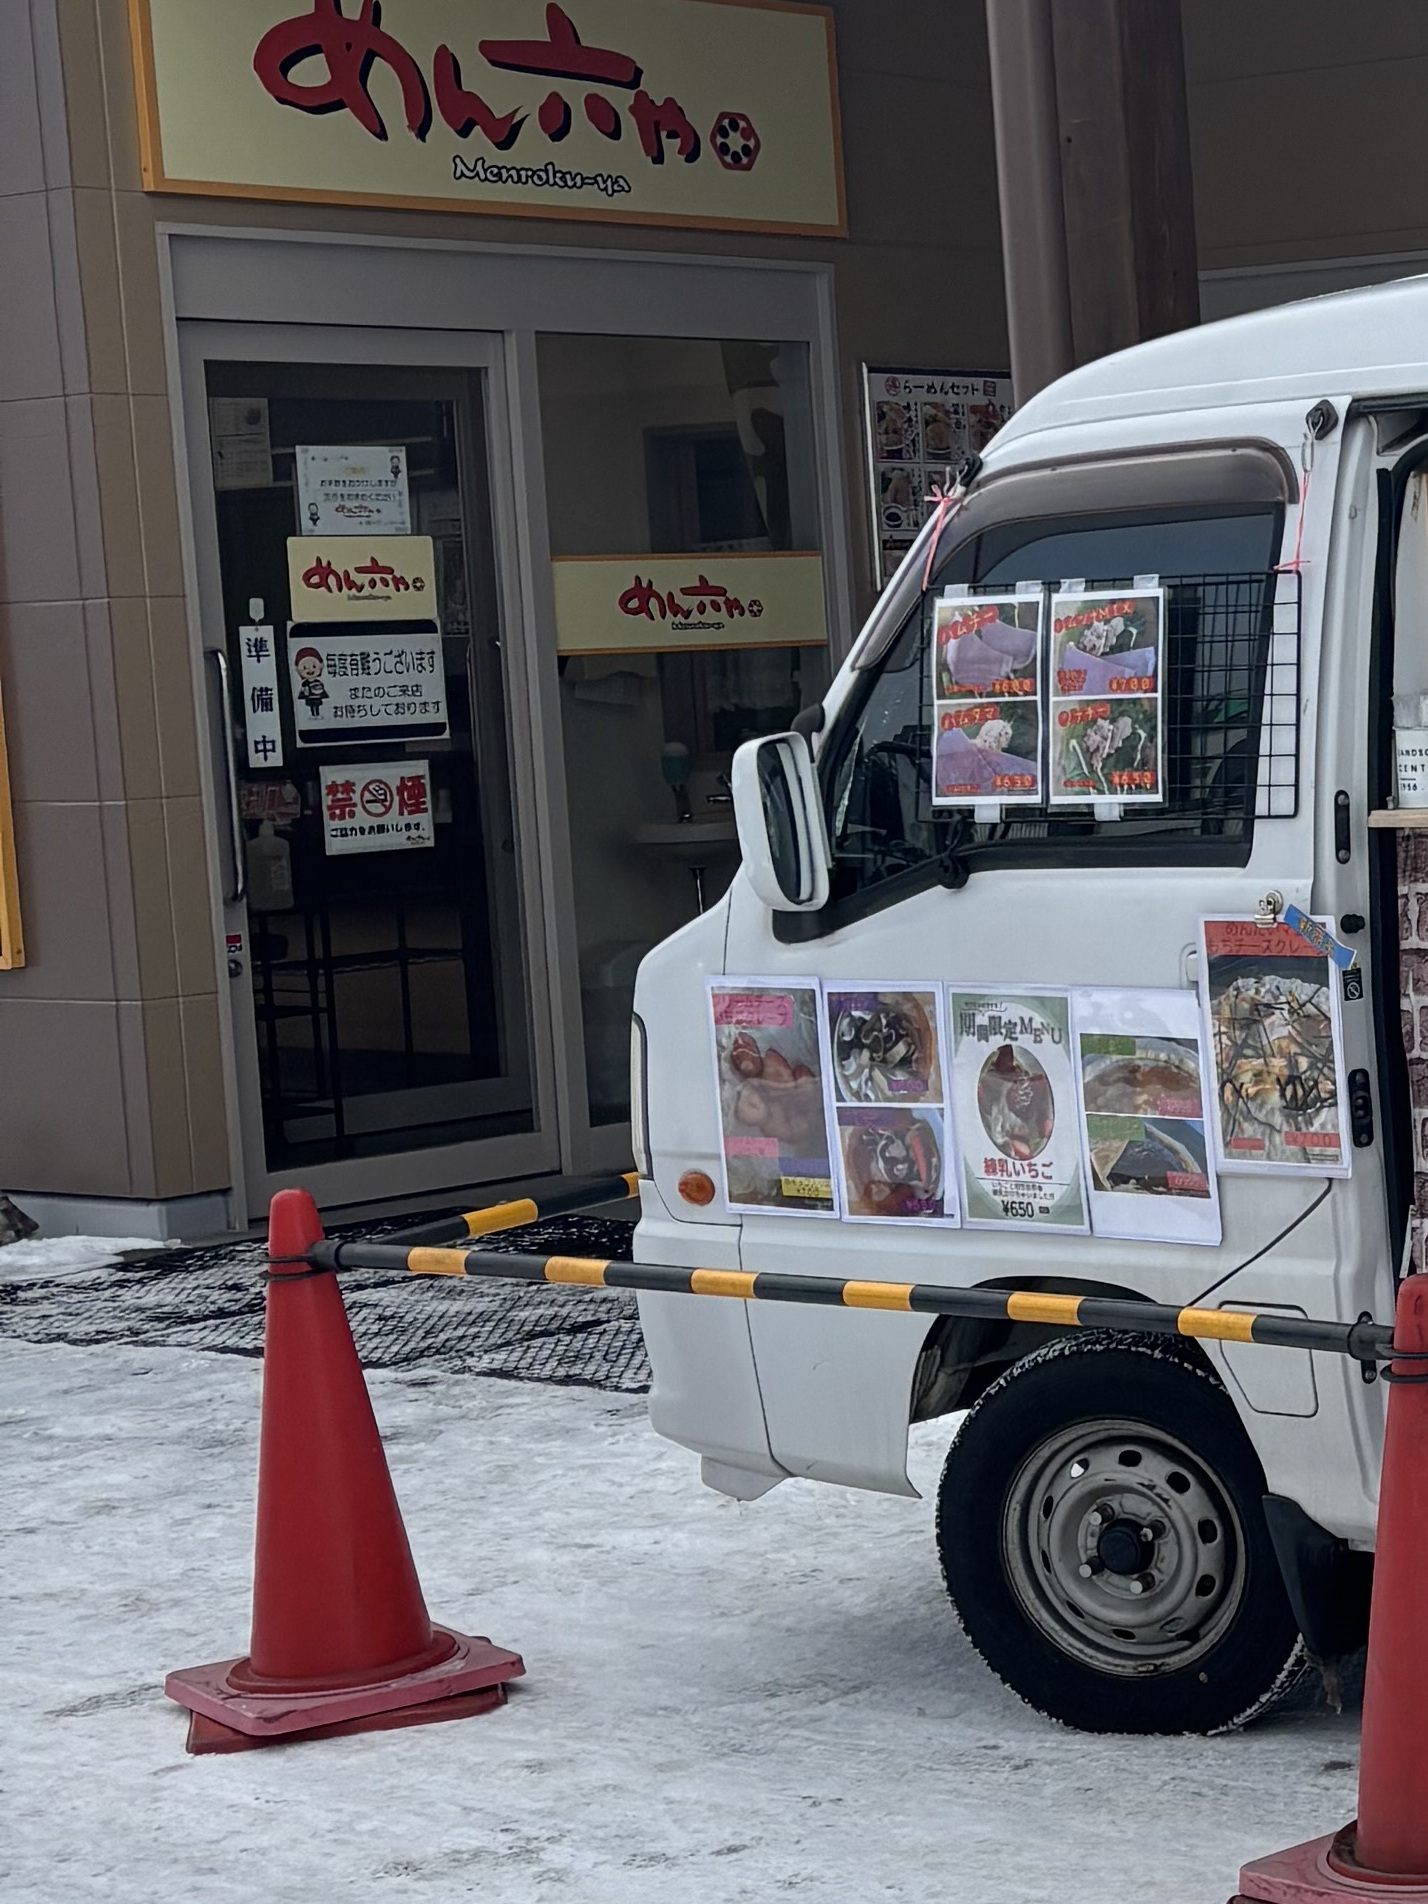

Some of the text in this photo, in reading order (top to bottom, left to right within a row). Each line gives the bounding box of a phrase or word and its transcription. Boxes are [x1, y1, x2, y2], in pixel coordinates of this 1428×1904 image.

[452, 154, 632, 197] Menroku-ya
[245, 637, 277, 762] 準備中
[1001, 1200, 1035, 1218] ¥650
